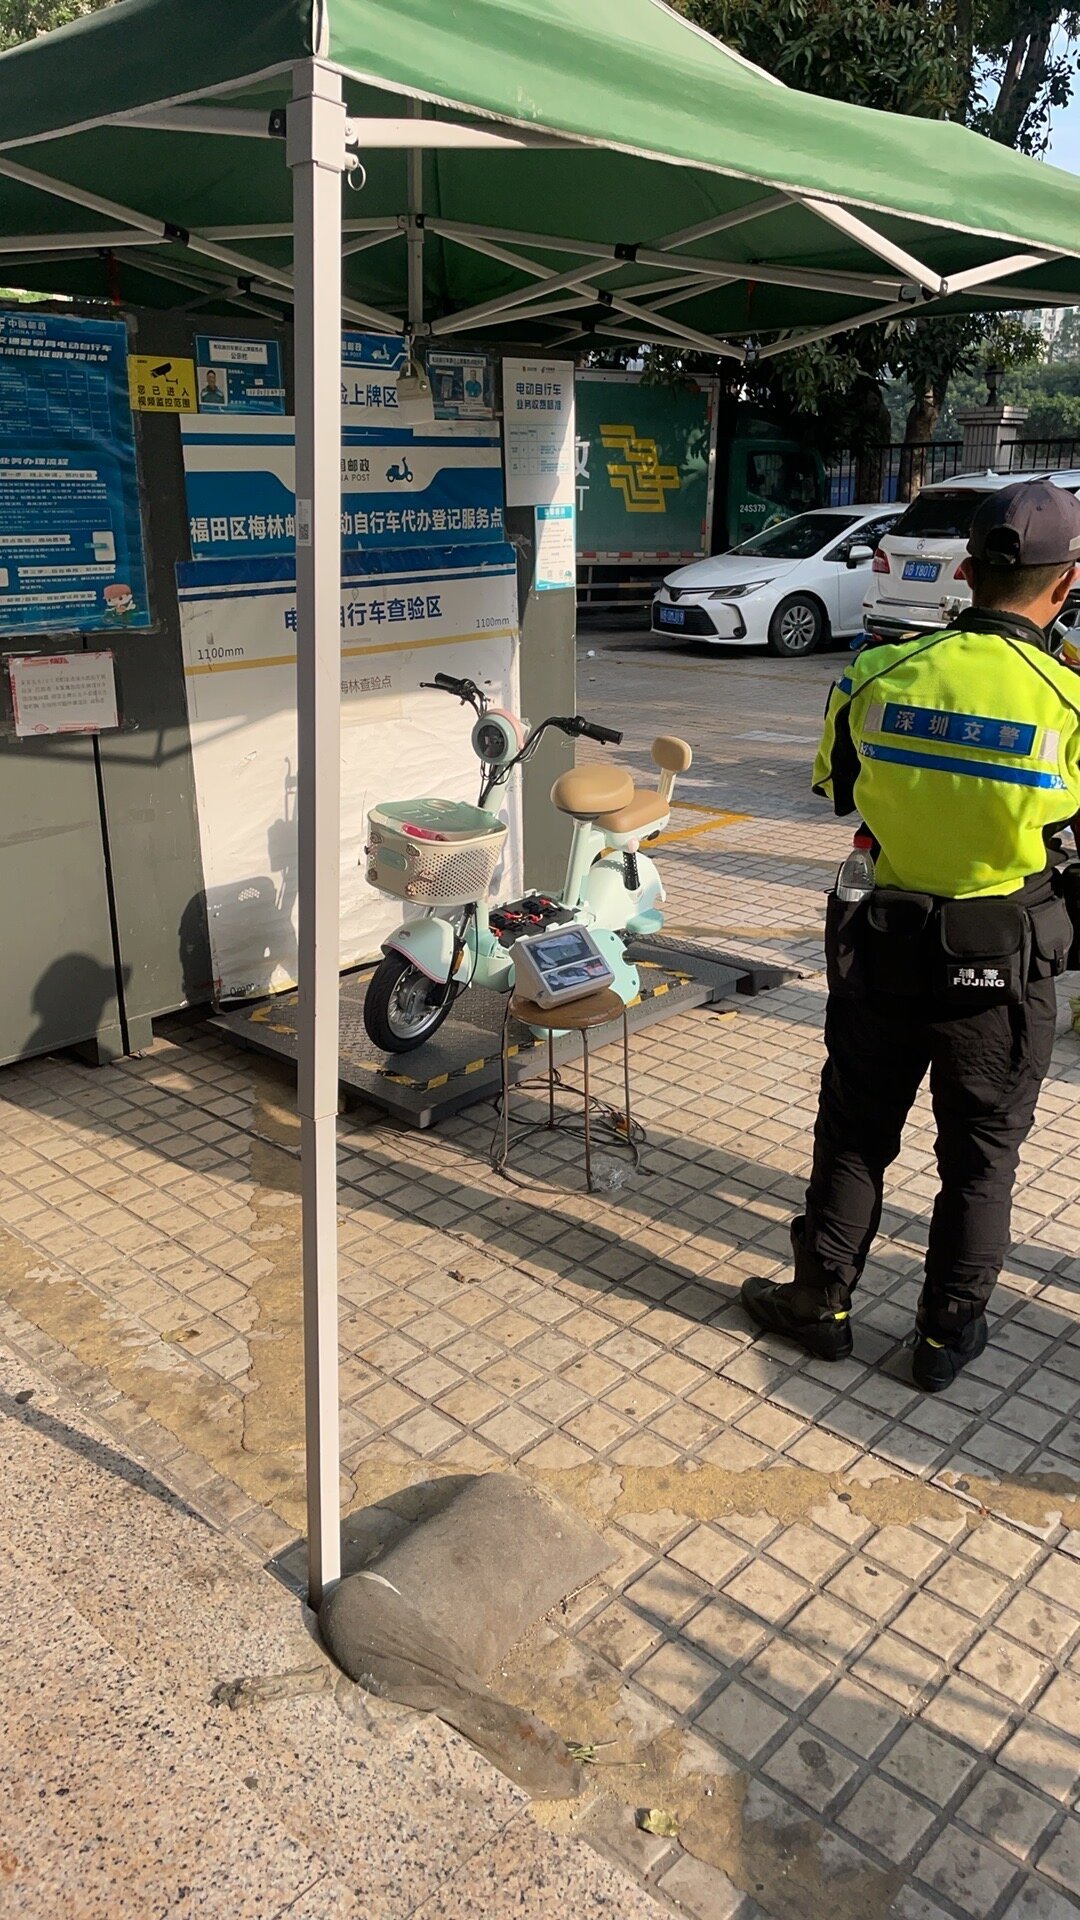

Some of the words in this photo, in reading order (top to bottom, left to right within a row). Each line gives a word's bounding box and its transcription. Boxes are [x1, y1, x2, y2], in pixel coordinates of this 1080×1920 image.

[138, 384, 189, 397] 您已进入
[516, 383, 561, 395] 电动自行车
[138, 396, 190, 408] 视频监控范围
[517, 399, 562, 410] 业务收费标准
[740, 504, 766, 513] 24S379
[476, 617, 510, 628] 1100mm
[197, 646, 244, 660] 1100mm
[895, 710, 1020, 748] 深圳交警
[959, 968, 999, 979] 辅警
[953, 977, 1005, 987] FUJING
